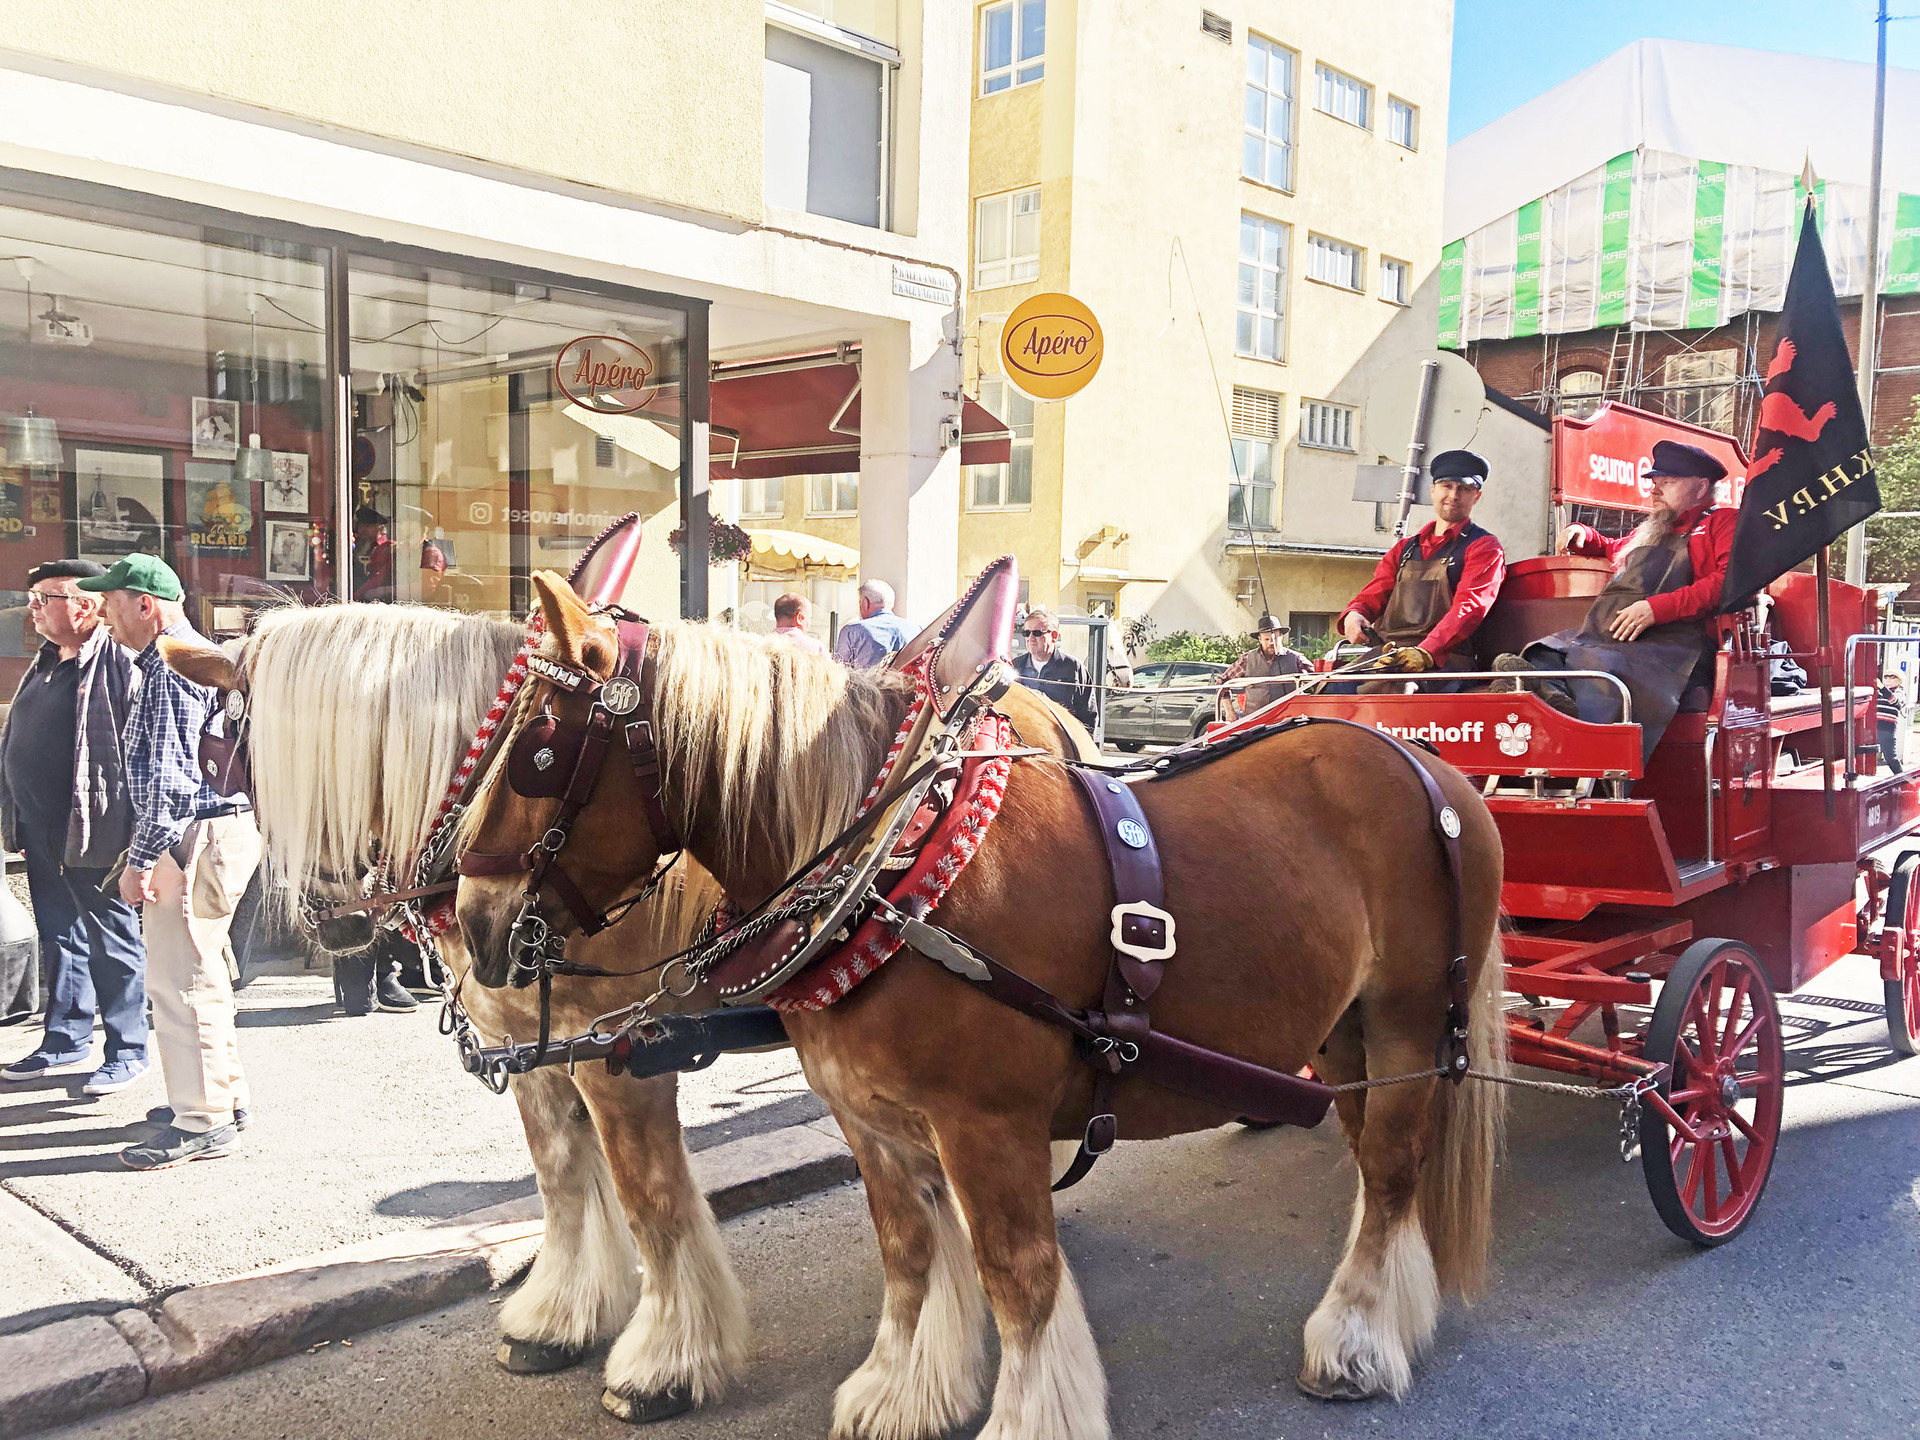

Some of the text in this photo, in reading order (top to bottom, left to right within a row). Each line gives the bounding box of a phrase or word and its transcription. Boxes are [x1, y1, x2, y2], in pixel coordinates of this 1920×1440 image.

[1607, 170, 1631, 180] KAS
[1698, 173, 1725, 184] KAS
[1603, 210, 1629, 221] KAS
[1696, 215, 1722, 227] KAS
[1518, 232, 1540, 242] KAS
[1603, 250, 1627, 260] KAS
[1442, 257, 1463, 266] KAS
[1693, 257, 1721, 268] KAS
[1516, 271, 1539, 280] KAS
[1440, 295, 1461, 303] KAS
[1601, 290, 1625, 300] KAS
[1691, 298, 1718, 309] KAS
[1516, 309, 1539, 318] KAS
[1023, 326, 1087, 365] Apéro
[575, 348, 646, 398] Apéro
[1590, 453, 1635, 487] seuraa
[190, 532, 248, 546] RICARD
